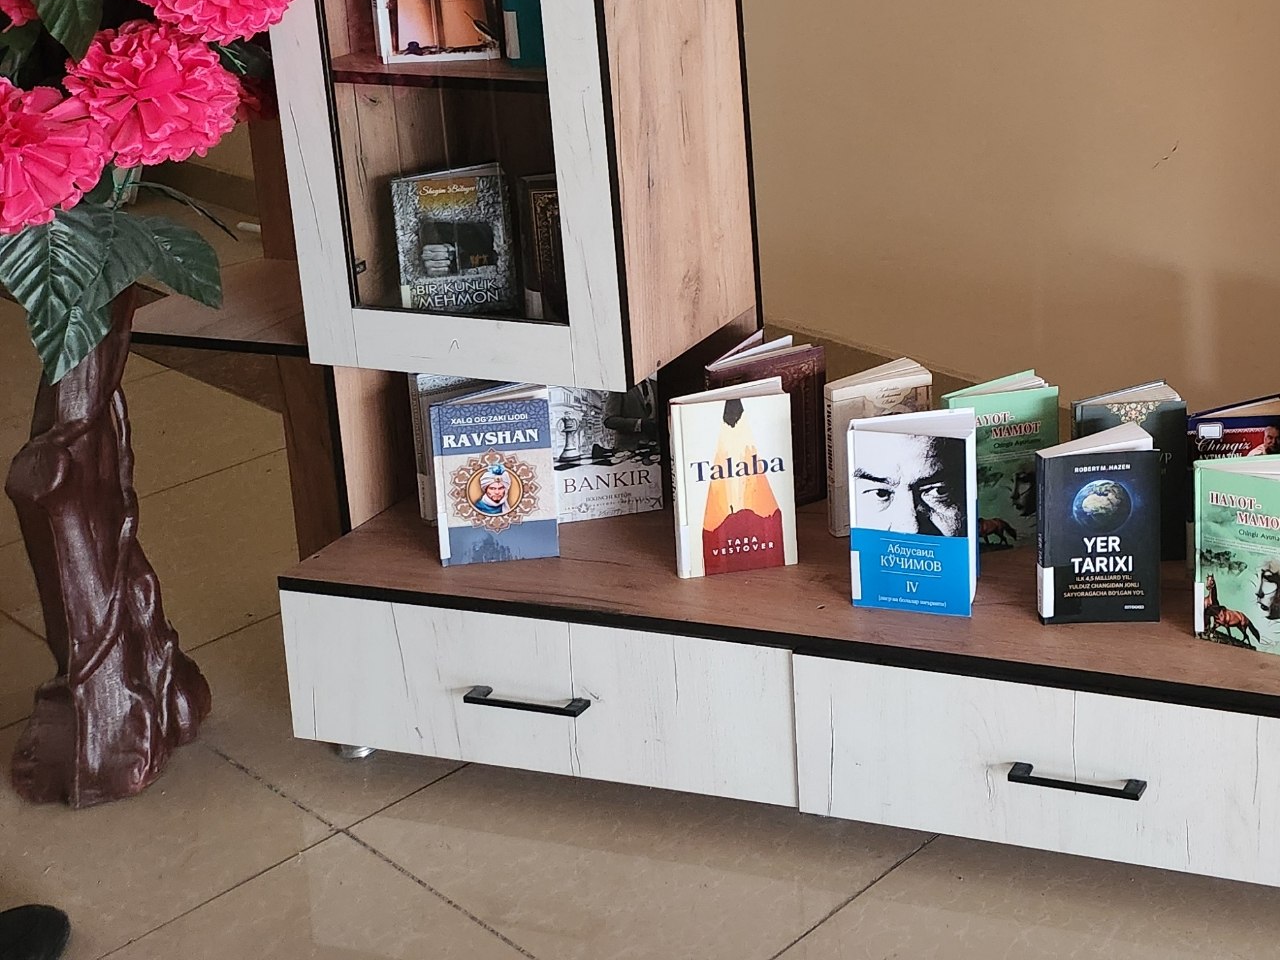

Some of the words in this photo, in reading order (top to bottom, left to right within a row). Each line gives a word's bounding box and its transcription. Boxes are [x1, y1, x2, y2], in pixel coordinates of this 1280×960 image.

[417, 285, 438, 295] BIR
[443, 279, 498, 292] KUNLIK
[418, 290, 500, 309] MEHMON
[451, 417, 473, 425] XALQ
[975, 412, 1014, 427] AYOT-
[992, 422, 1041, 438] MAMOT
[443, 429, 540, 448] RAVSHAN
[690, 455, 785, 483] Talaba
[564, 469, 652, 494] BANKIR
[1209, 491, 1262, 510] HAYOT-
[713, 542, 774, 555] VESTOVER
[728, 537, 758, 545] TARA
[1083, 536, 1120, 553] YER
[887, 545, 935, 558] Абдусаид
[880, 554, 942, 572] КЎЧИМОВ
[1071, 556, 1133, 574] TARIXI
[906, 581, 919, 592] IV
[1063, 590, 1107, 598] SAYYORAGACHA
